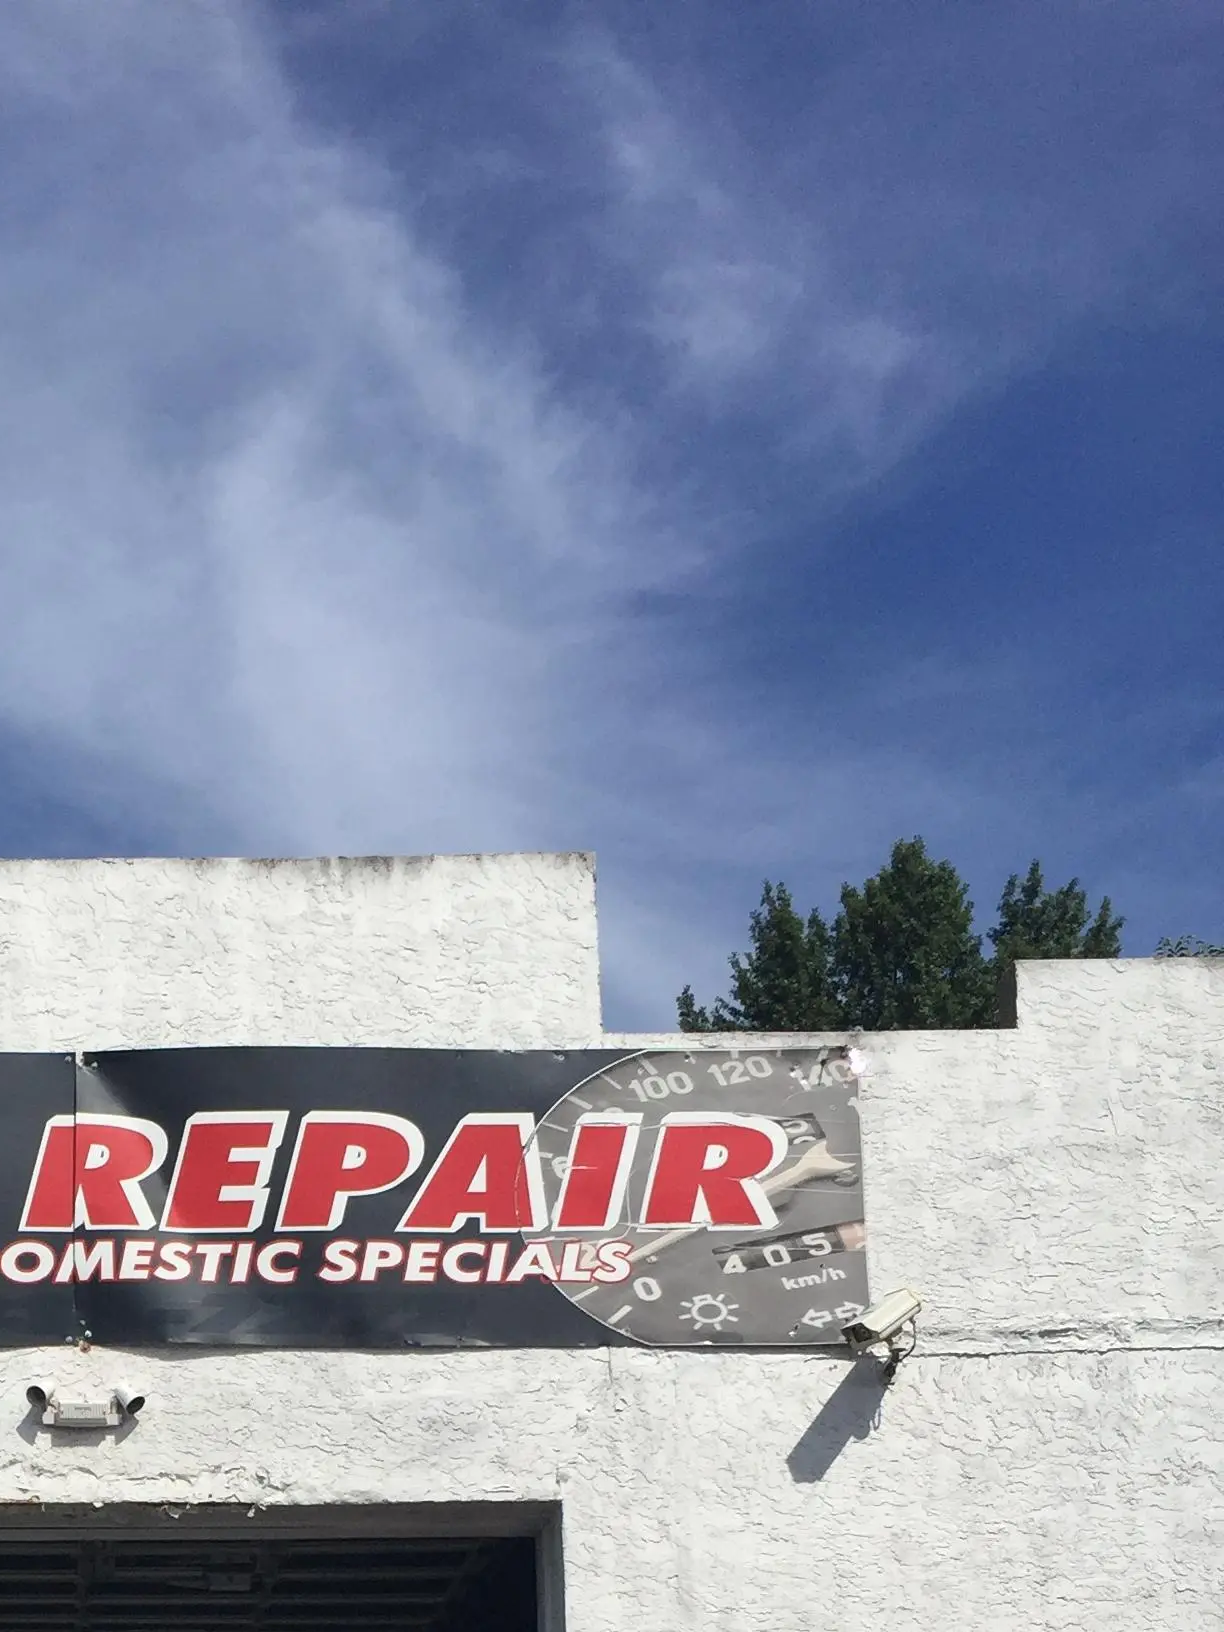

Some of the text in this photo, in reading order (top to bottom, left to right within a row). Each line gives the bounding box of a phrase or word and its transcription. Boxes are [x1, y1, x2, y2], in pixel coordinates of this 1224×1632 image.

[628, 1071, 694, 1103] 100
[707, 1056, 773, 1087] 120
[18, 1111, 788, 1233] REPAIR
[317, 1242, 635, 1284] SPECIALS
[633, 1277, 663, 1302] 0
[781, 1267, 847, 1291] km/h
